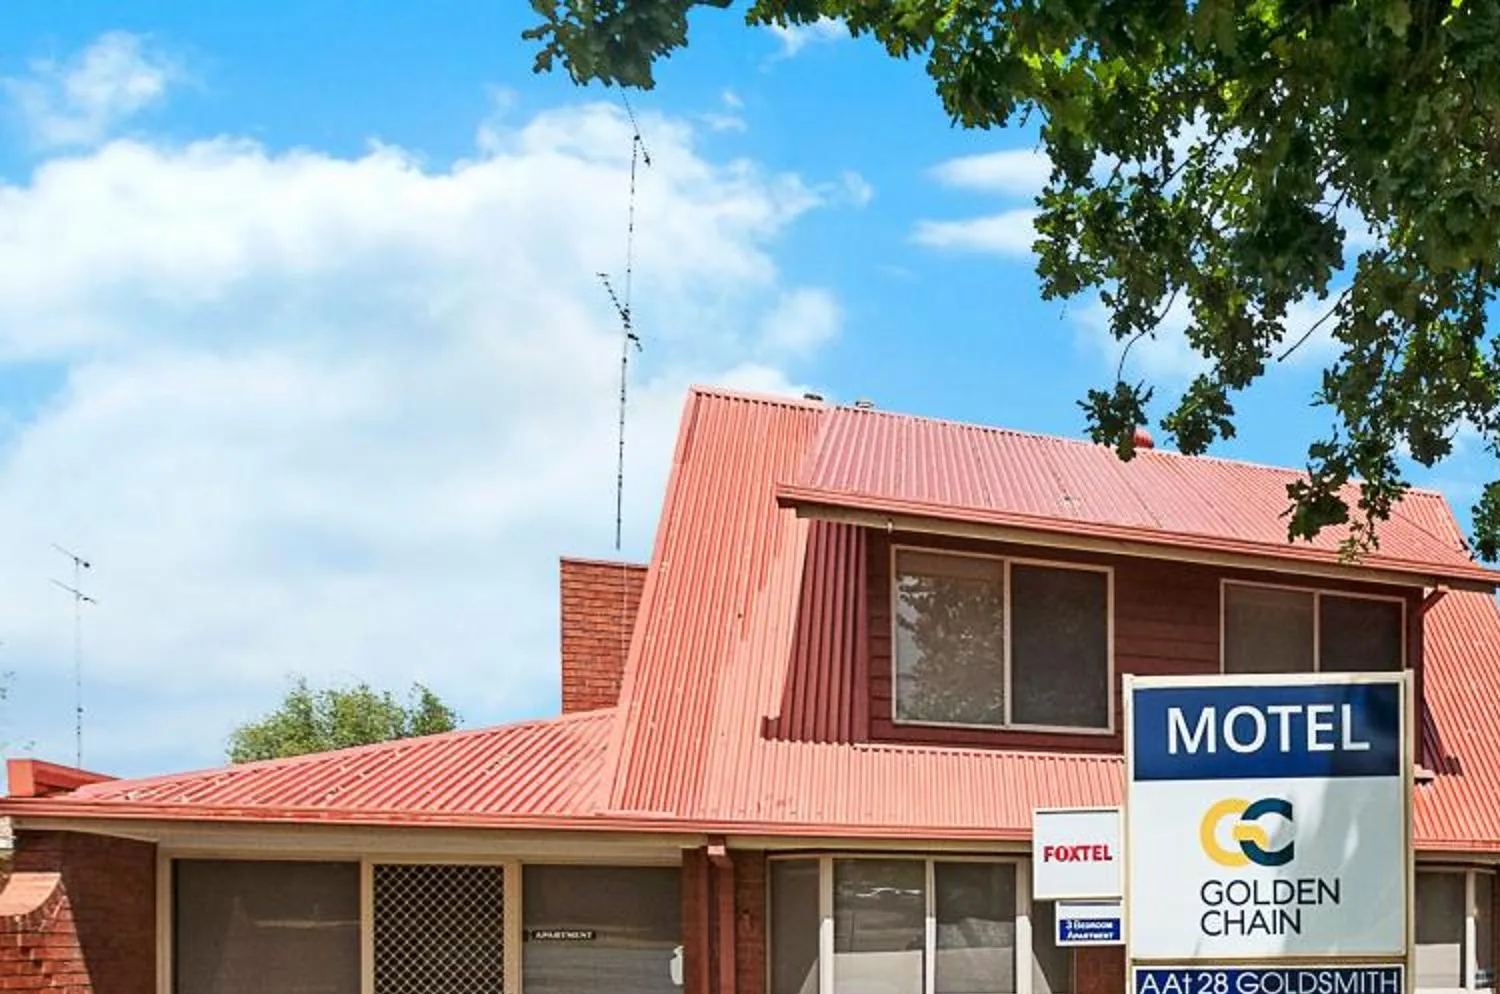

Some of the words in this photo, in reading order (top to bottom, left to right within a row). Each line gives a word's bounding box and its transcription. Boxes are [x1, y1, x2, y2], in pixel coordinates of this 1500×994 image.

[1168, 704, 1370, 754] MOTEL
[1043, 844, 1113, 863] FOXTEL
[1201, 878, 1340, 906] GOLDEN
[1200, 909, 1302, 936] CHAIN
[1235, 971, 1398, 994] GOLDSMITH
